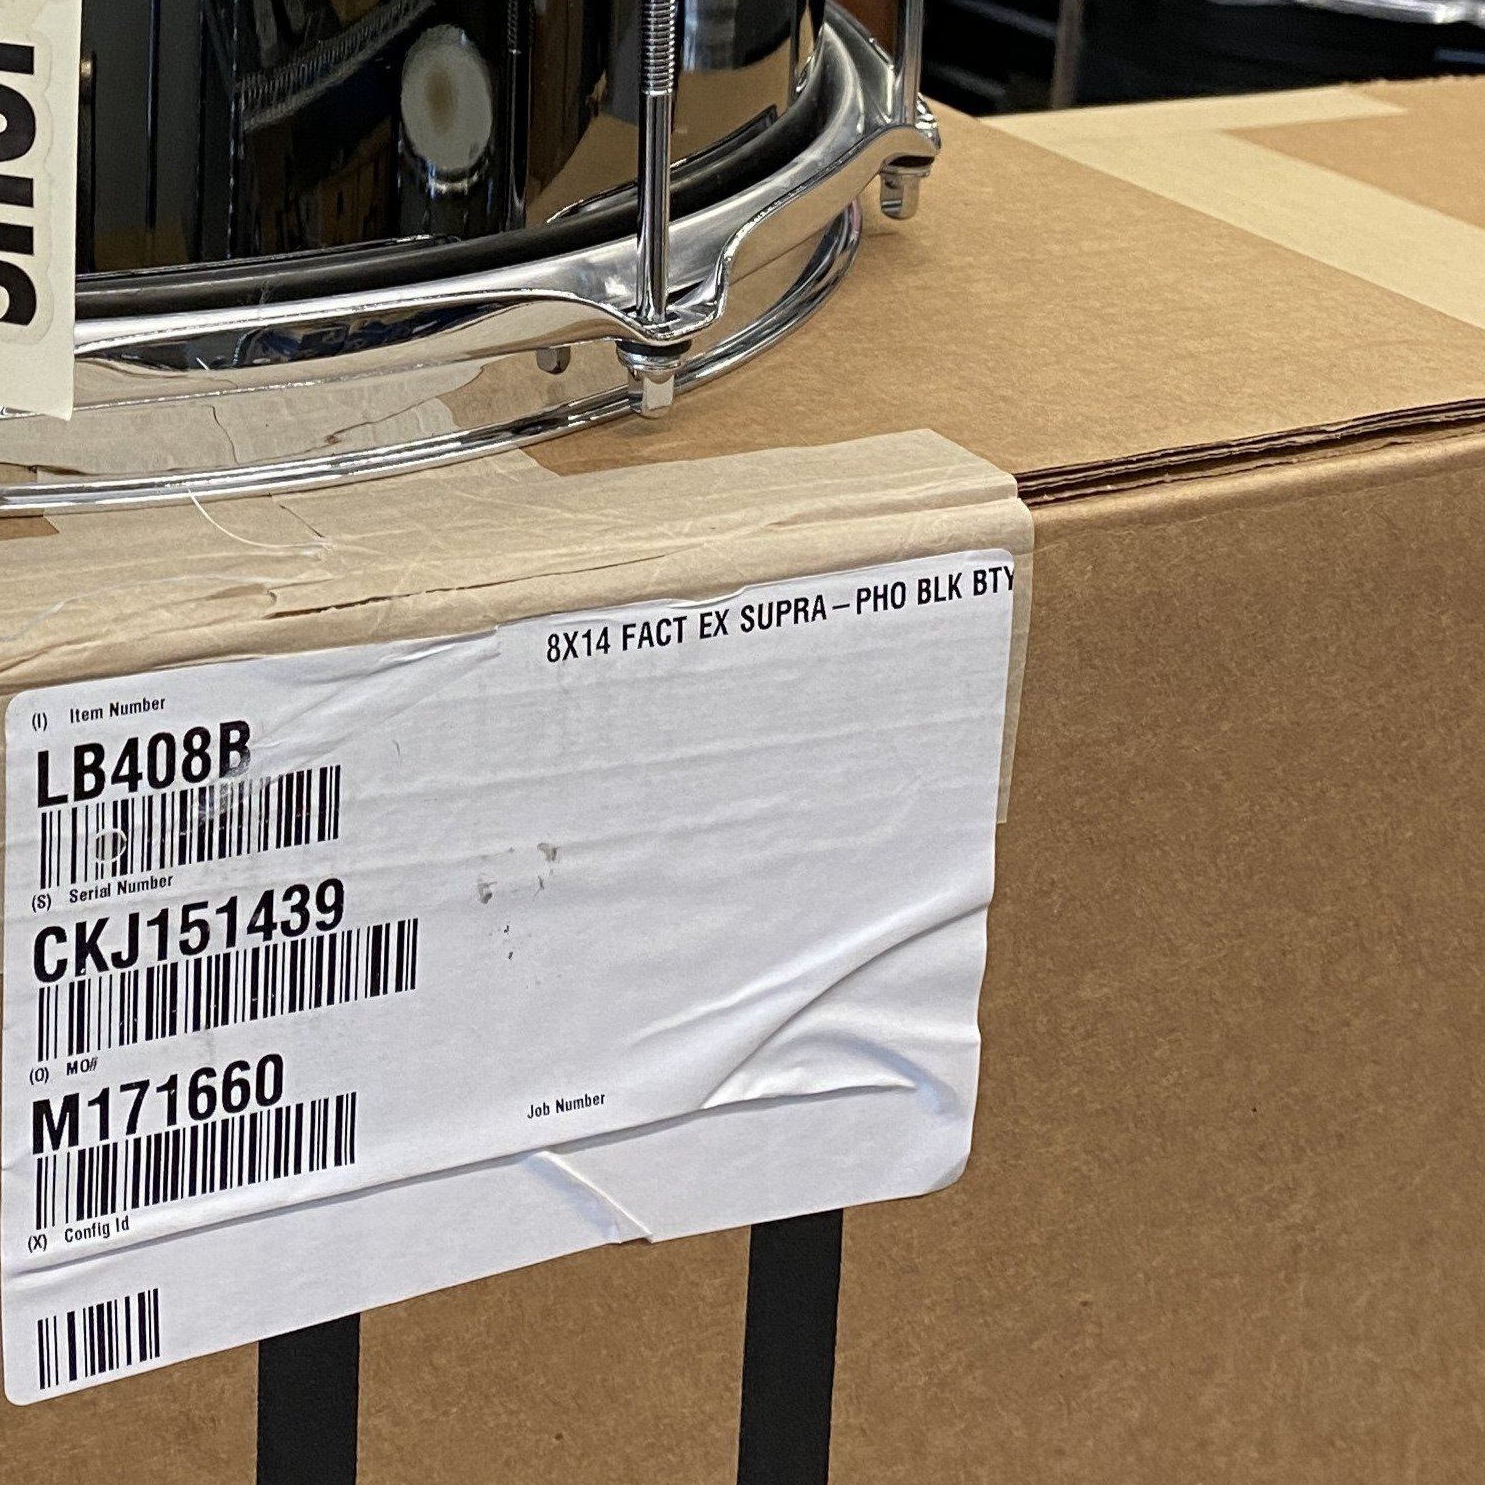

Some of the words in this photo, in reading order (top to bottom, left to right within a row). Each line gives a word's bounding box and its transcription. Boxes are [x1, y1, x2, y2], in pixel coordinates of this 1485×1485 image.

[546, 627, 611, 664] 8X14
[621, 615, 687, 651] FACT
[698, 609, 730, 640] EX
[917, 572, 963, 606] BLK
[70, 706, 103, 724] Item
[109, 697, 166, 718] Number
[37, 720, 251, 808] LB408B
[31, 894, 52, 912] (S)
[69, 883, 112, 903] Serial
[117, 874, 174, 895] Number
[33, 878, 345, 983] CKJ151439
[31, 1053, 284, 1156] M171660
[527, 1102, 550, 1120] Job
[554, 1092, 606, 1113] Number
[27, 1233, 47, 1253] (X)
[64, 1223, 110, 1242] Config
